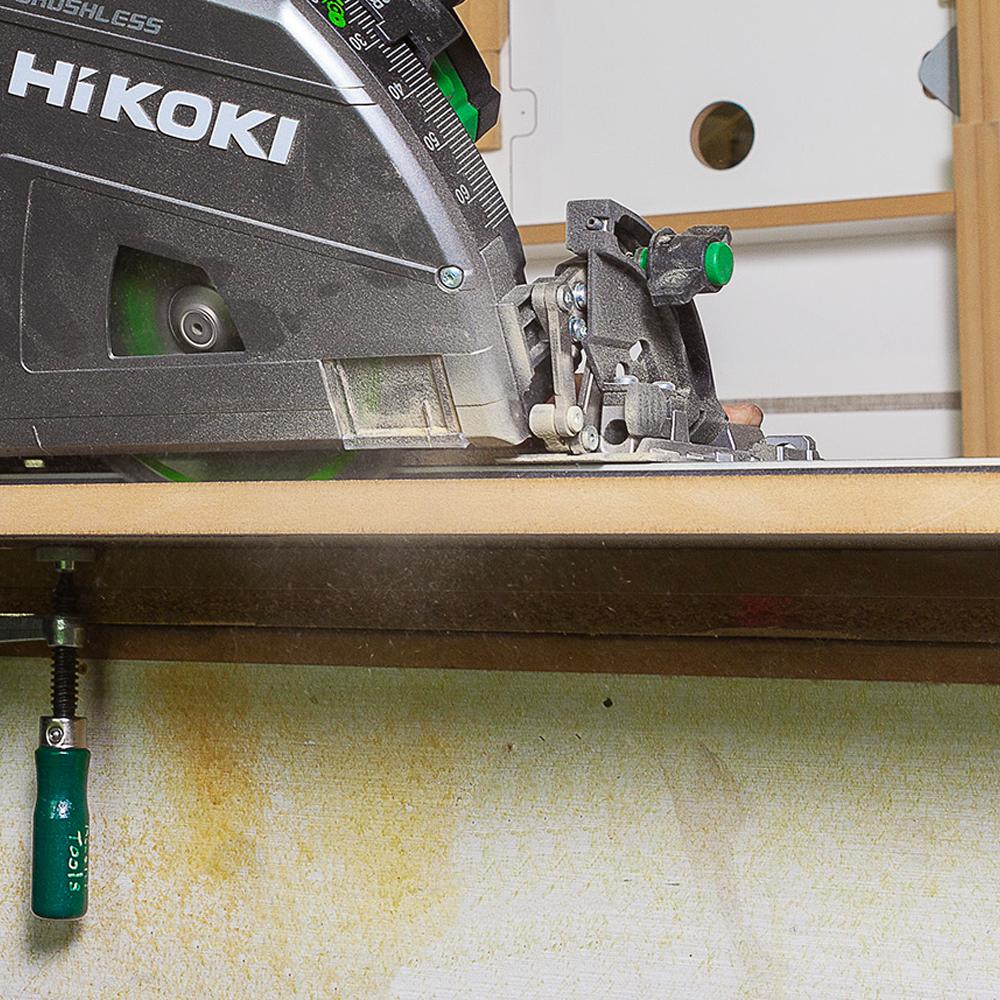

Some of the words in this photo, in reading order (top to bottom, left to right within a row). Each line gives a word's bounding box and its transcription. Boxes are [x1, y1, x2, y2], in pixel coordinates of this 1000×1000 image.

[348, 32, 368, 51] 30
[387, 82, 405, 101] 40
[423, 131, 441, 152] 50
[454, 184, 471, 205] 60
[67, 829, 84, 892] Tools
